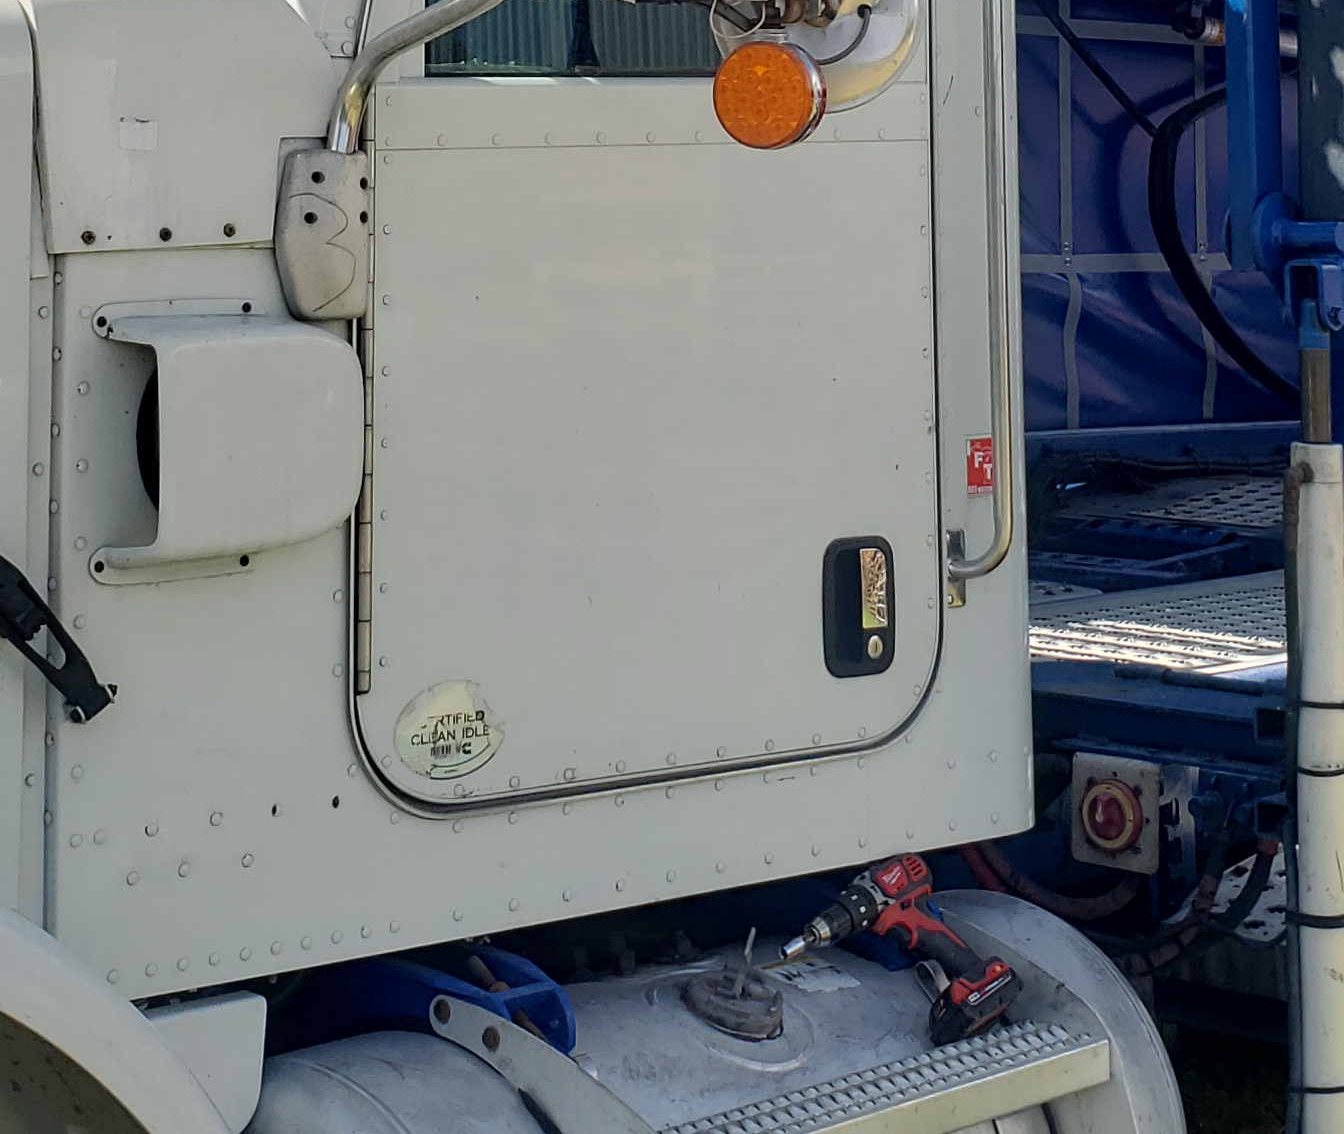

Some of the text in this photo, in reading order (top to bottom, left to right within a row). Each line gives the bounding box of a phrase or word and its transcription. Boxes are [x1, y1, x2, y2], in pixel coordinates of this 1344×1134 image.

[421, 710, 485, 729] RTIFIED
[411, 724, 490, 747] CLEAN IDLE
